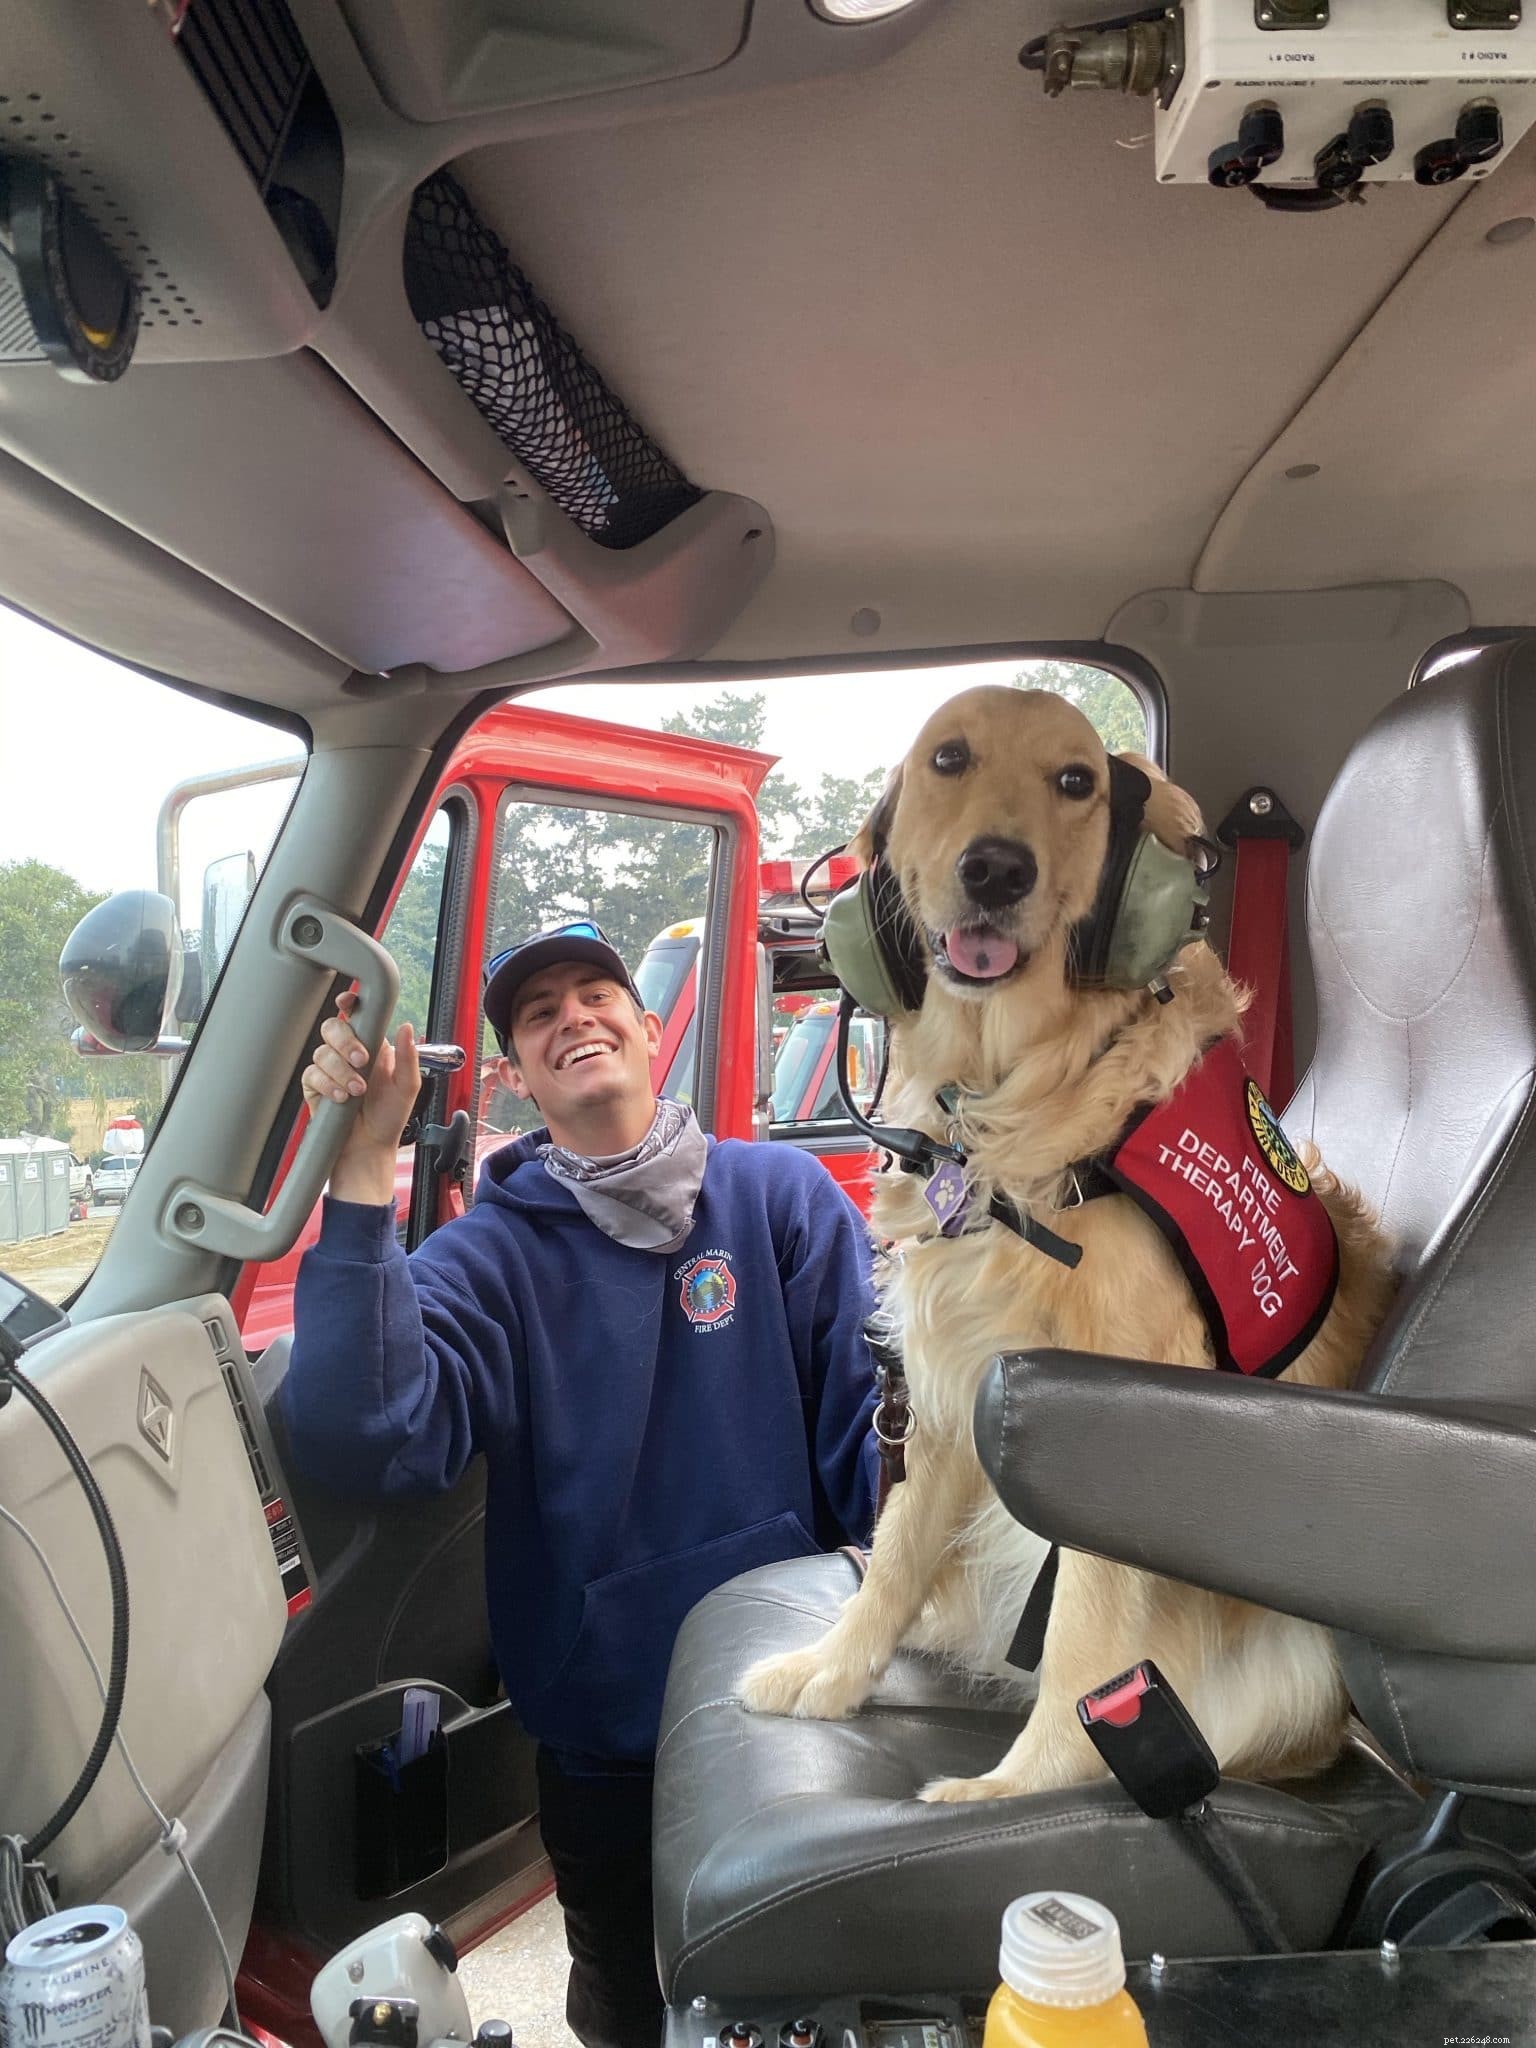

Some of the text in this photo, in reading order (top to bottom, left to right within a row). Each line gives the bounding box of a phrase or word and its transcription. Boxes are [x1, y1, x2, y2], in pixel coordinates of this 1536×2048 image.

[1284, 53, 1315, 61] RADIO
[1477, 52, 1507, 60] RADIO
[1251, 1115, 1274, 1157] FIRE
[1242, 1155, 1282, 1216] FIRE
[1177, 1128, 1299, 1282] DEPARTMENT
[1157, 1144, 1283, 1318] THERAPY DOG
[673, 1248, 733, 1280] CENTRAL MARIN
[694, 1313, 735, 1334] FIRE DEPT
[40, 1956, 111, 1986] TAURINE
[45, 1985, 113, 2017] MONSTER
